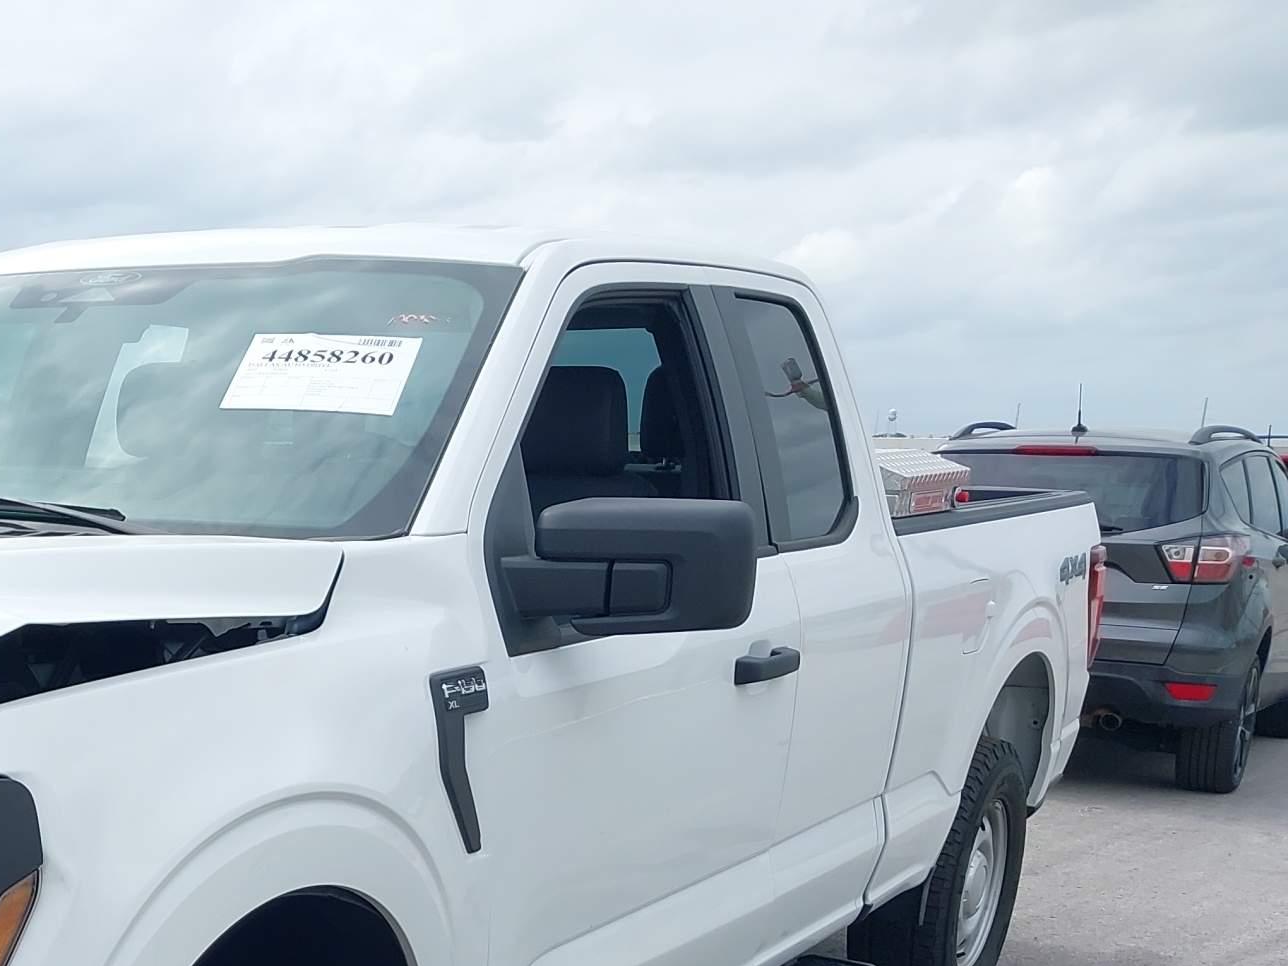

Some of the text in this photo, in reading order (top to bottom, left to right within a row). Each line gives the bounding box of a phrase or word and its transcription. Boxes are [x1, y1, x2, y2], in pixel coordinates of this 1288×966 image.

[261, 348, 395, 366] 44858260
[441, 677, 487, 698] F-150
[448, 700, 460, 710] XL
